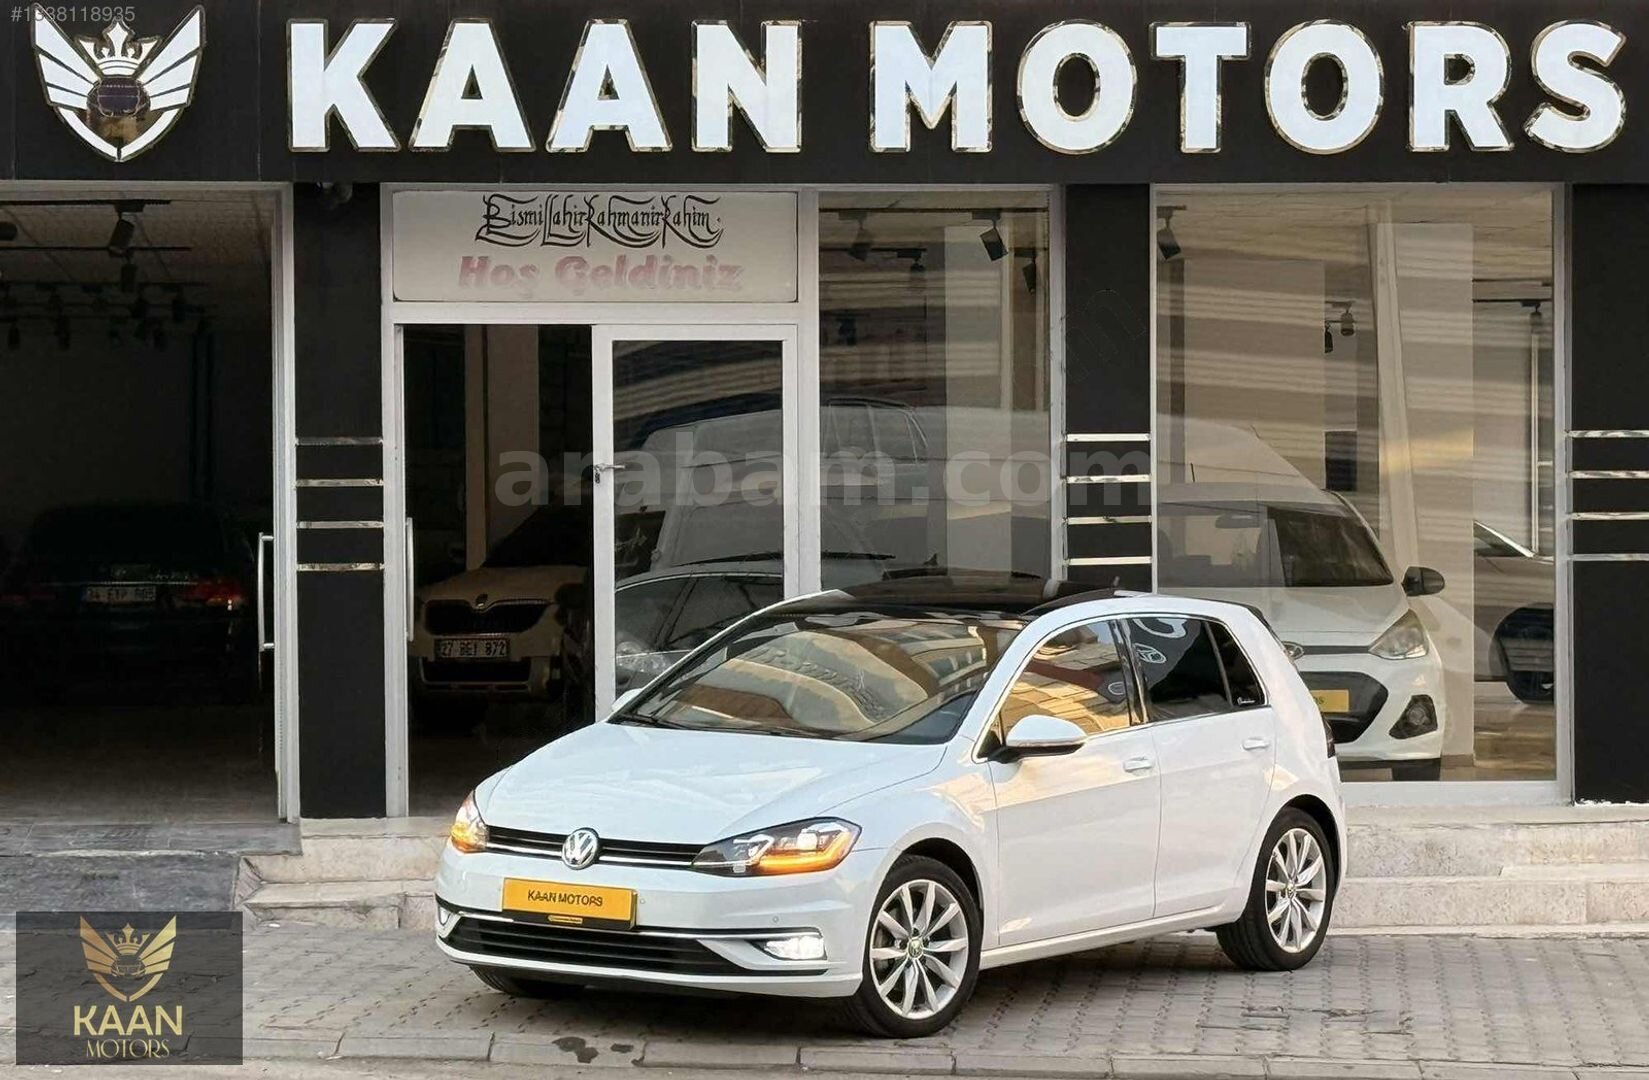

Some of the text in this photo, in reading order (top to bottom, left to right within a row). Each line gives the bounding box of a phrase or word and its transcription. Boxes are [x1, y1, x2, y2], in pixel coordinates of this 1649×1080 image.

[286, 18, 1627, 154] KAAN MOTORS
[458, 254, 744, 299] Hoş Geldiniz
[527, 889, 604, 907] KAAN MOTORS
